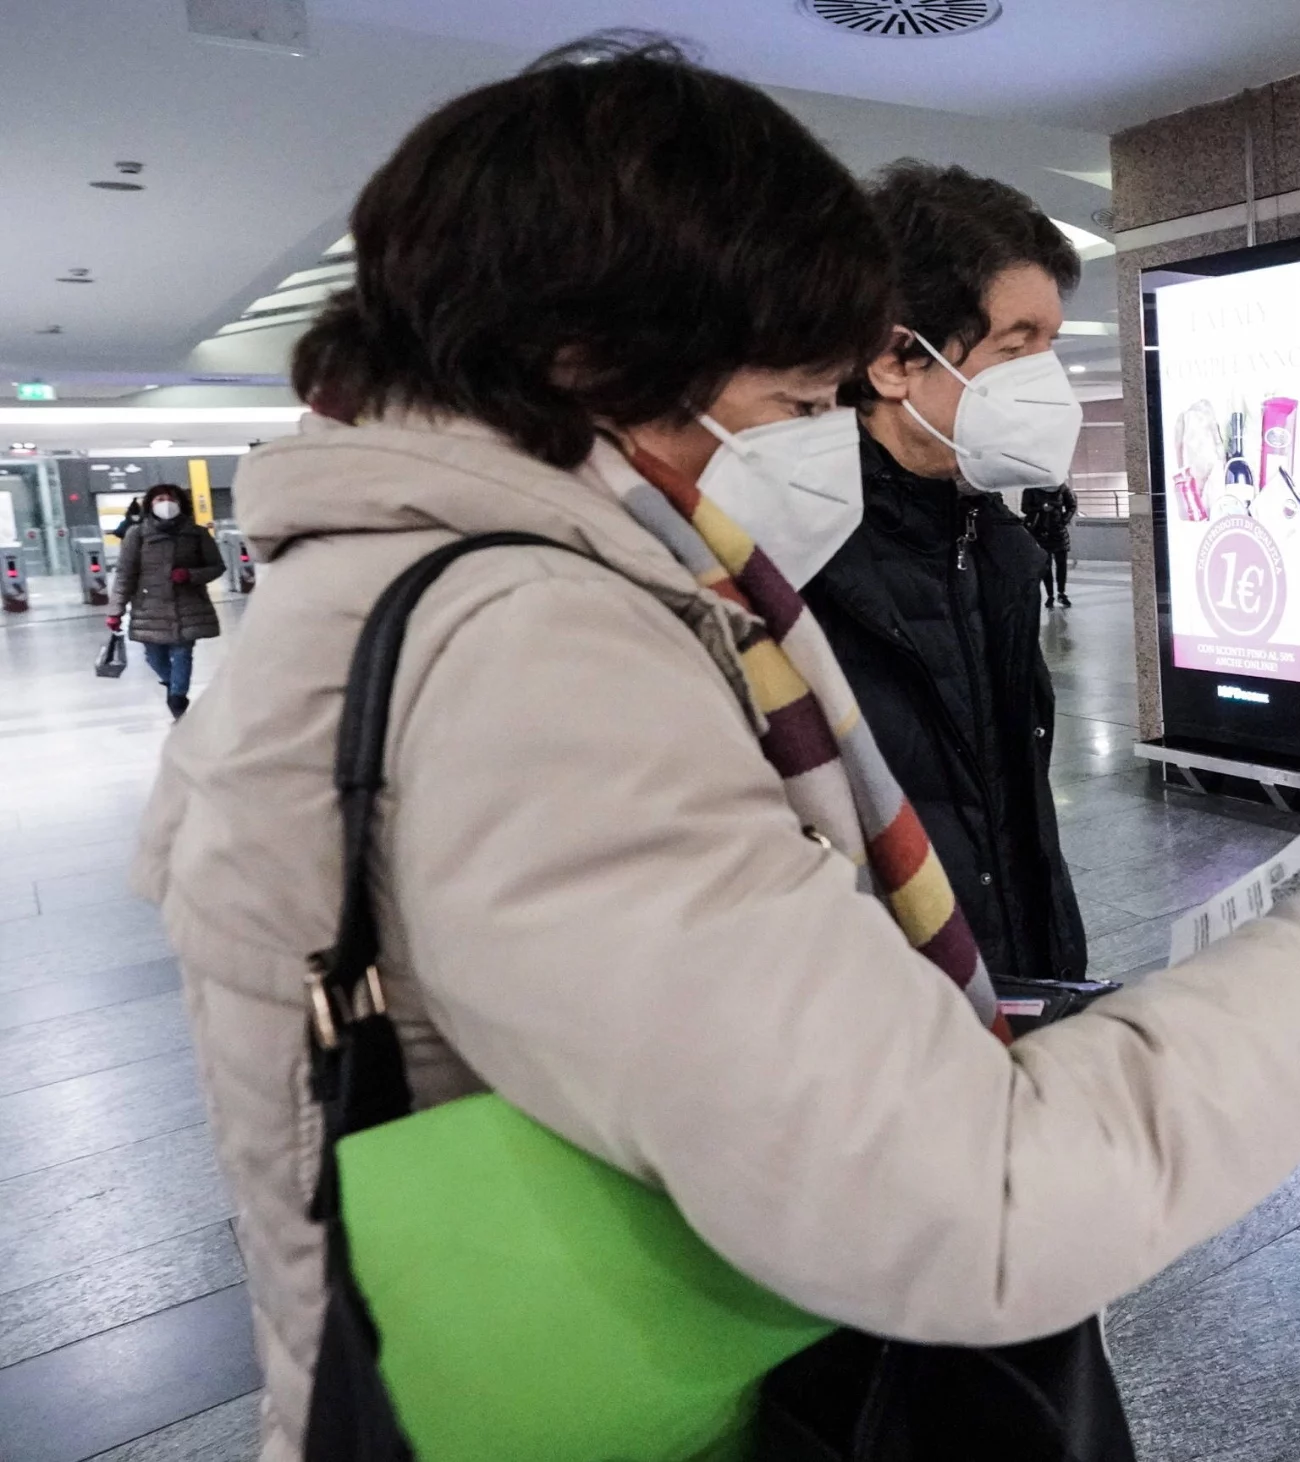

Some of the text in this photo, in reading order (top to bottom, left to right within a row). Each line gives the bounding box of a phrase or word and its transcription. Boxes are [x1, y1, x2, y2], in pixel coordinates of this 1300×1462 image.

[1208, 518, 1244, 542] PRODOTTI
[1243, 519, 1254, 531] DI
[1197, 643, 1214, 653] CON
[1215, 645, 1245, 656] SCONTI
[1246, 648, 1267, 659] FINO
[1268, 651, 1279, 661] AL
[1215, 657, 1243, 668] ANCHE
